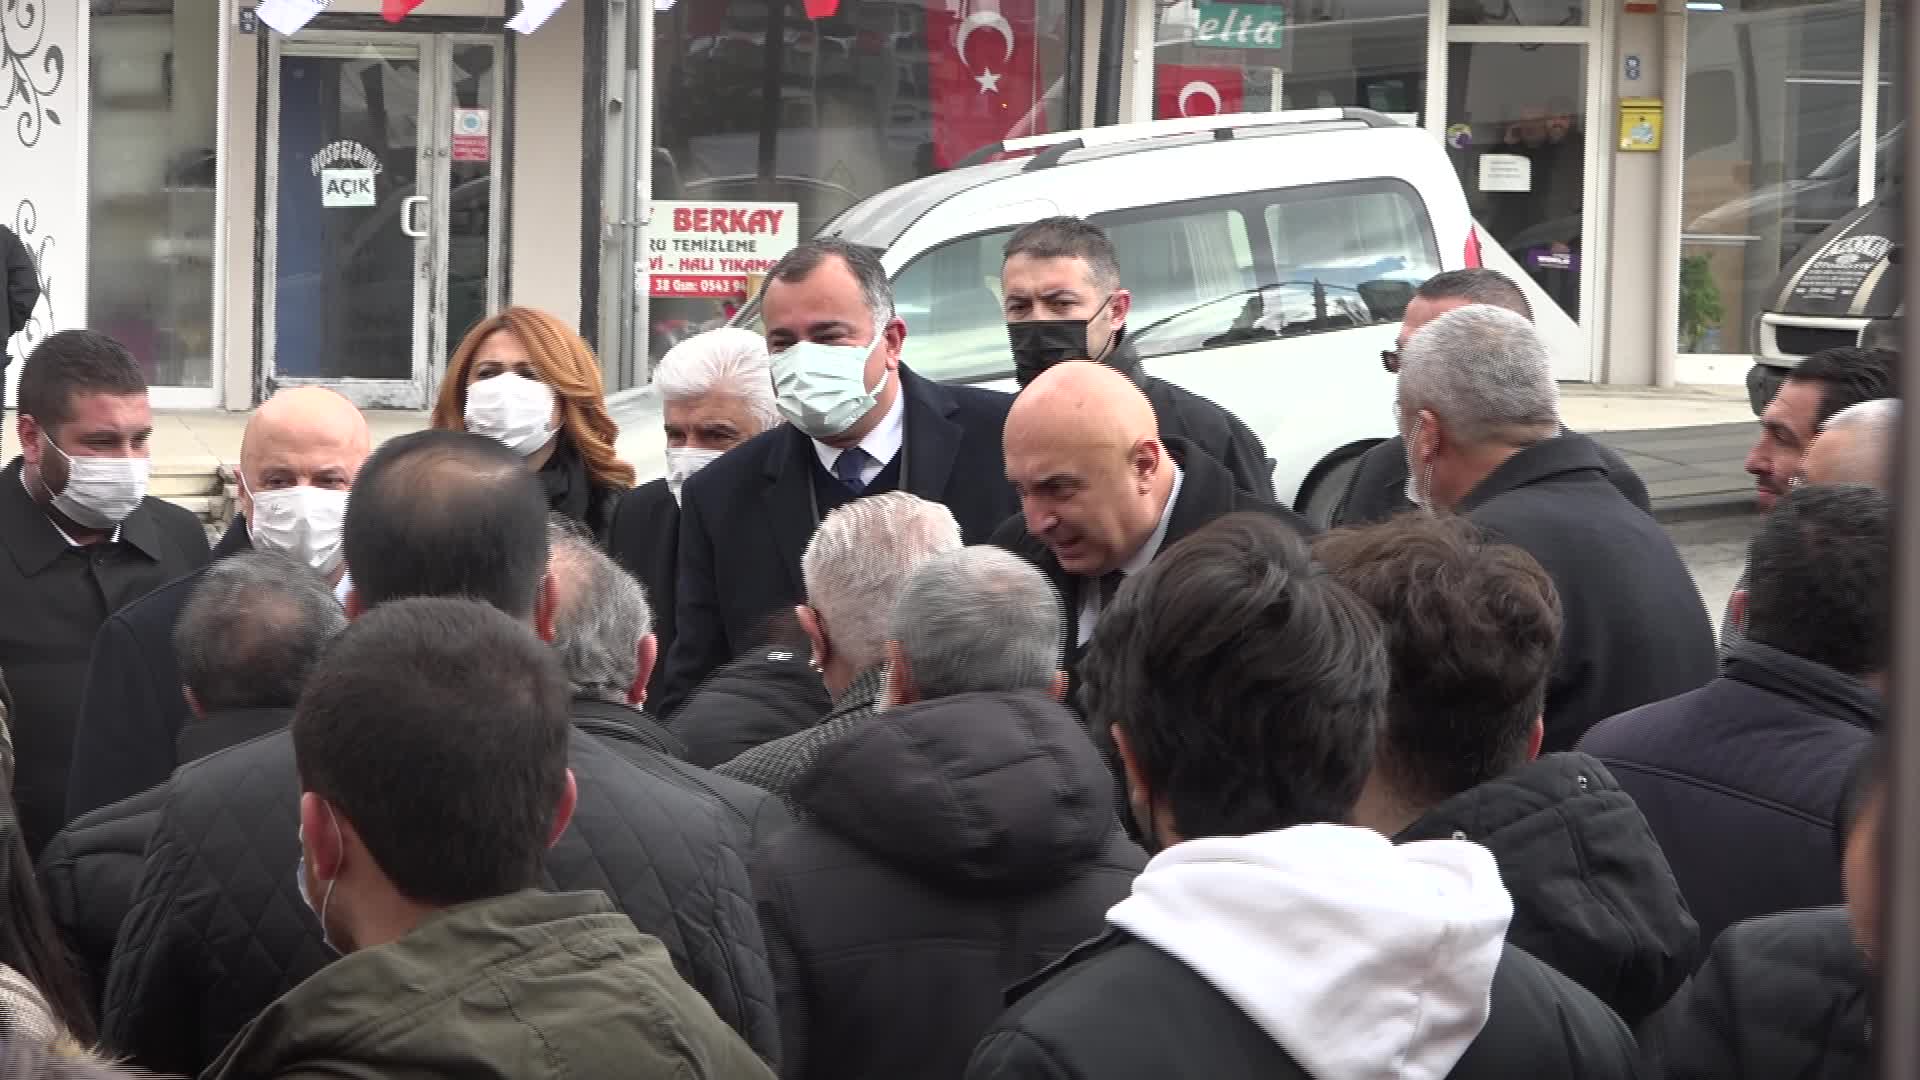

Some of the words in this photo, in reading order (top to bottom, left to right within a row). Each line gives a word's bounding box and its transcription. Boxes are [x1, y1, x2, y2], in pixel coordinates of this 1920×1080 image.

[326, 177, 371, 198] AÇIK
[673, 207, 784, 236] BERKAY
[672, 237, 757, 253] TEMİZLEME
